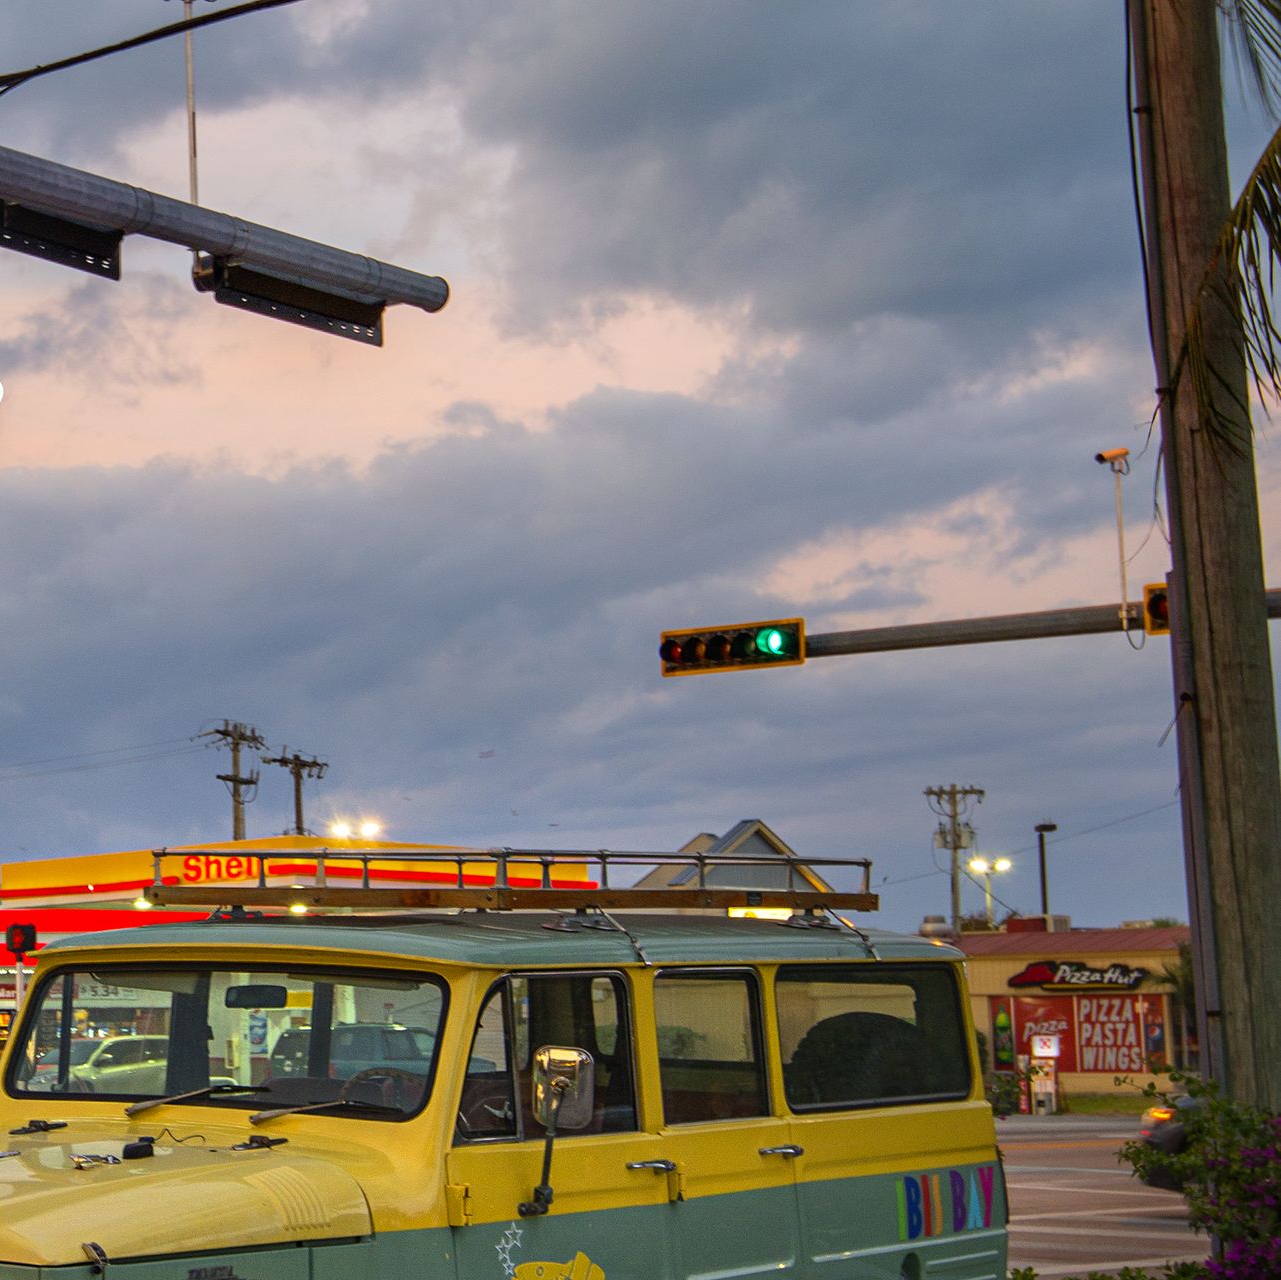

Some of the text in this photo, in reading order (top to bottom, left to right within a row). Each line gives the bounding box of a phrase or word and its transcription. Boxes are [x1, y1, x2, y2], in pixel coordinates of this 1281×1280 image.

[1054, 965, 1142, 984] Pizza Hut
[1080, 999, 1133, 1022] PIZZA
[1081, 1023, 1137, 1046] PASTA
[1083, 1047, 1142, 1070] WINGS
[895, 1166, 994, 1241] IBIS BAY
